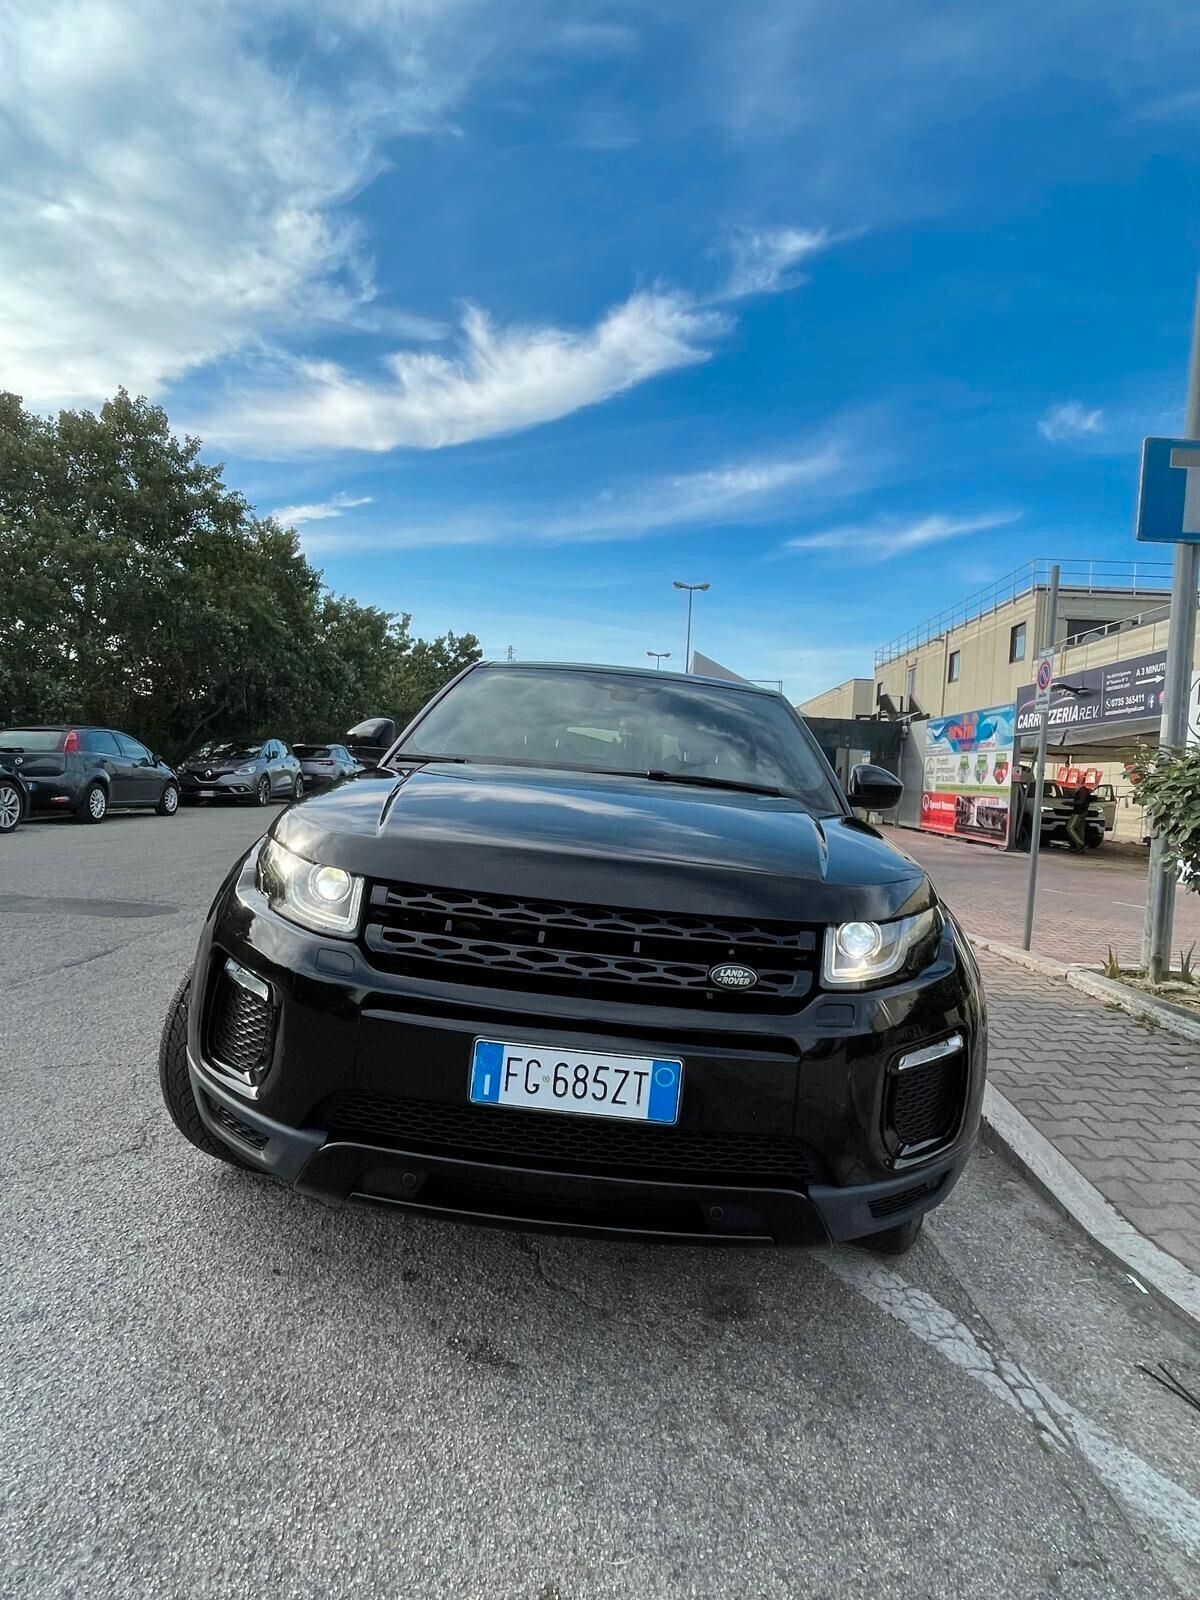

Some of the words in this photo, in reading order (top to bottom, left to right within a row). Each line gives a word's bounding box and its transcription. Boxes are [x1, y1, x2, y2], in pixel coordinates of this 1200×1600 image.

[1136, 668, 1140, 676] A
[1141, 666, 1146, 676] 3
[1018, 705, 1078, 729] CARRZERIA
[720, 969, 744, 978] LAND
[722, 976, 750, 984] ROVER
[504, 1056, 542, 1095] FG
[552, 1062, 649, 1108] 685ZT
